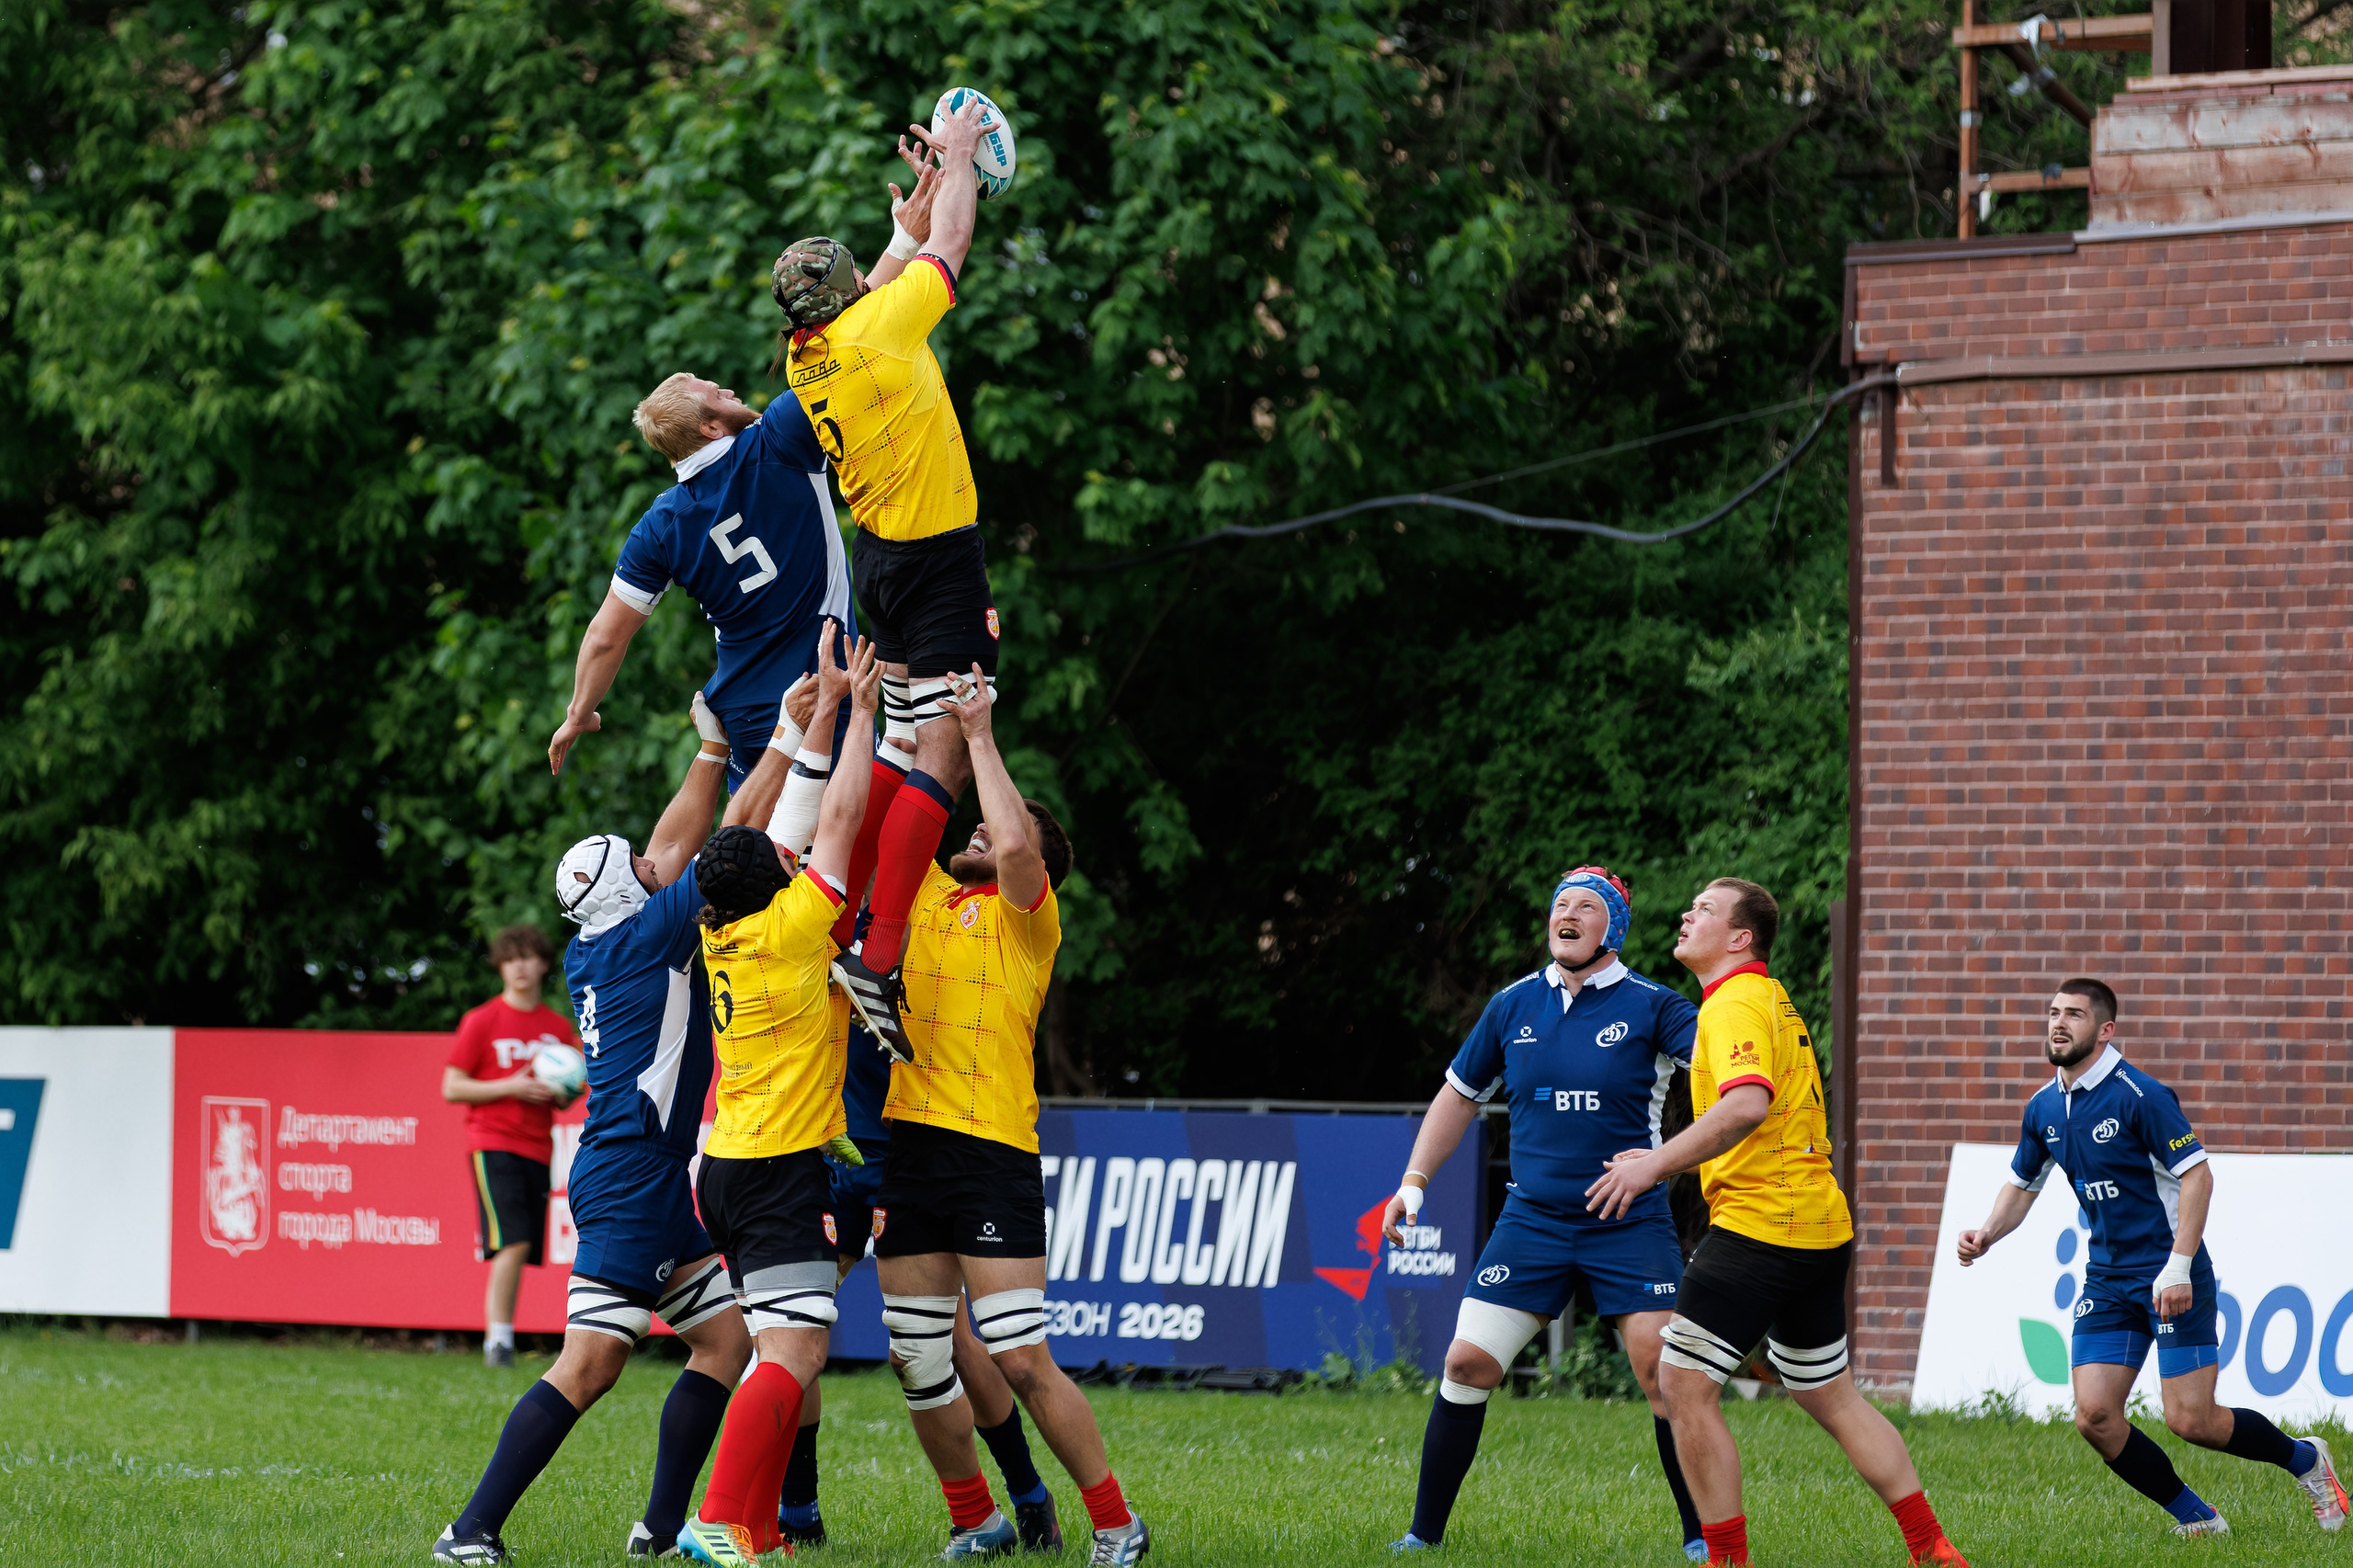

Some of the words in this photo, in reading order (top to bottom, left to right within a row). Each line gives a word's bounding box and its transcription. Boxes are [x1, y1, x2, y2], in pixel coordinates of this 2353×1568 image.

[710, 512, 779, 595] 5
[578, 984, 601, 1059] 4
[710, 970, 734, 1034] 6
[1555, 1090, 1601, 1111] ВТБ
[278, 1106, 418, 1153] Департамент
[278, 1162, 353, 1202] спорта
[2084, 1180, 2120, 1201] ВТБ
[278, 1210, 353, 1251] города
[353, 1207, 439, 1245] Москвы
[1088, 1156, 1298, 1289] РОССИИ
[1388, 1250, 1456, 1276] РОССИИ
[1654, 1283, 1677, 1295] ВТБ
[1117, 1302, 1205, 1341] 2026
[2158, 1324, 2174, 1334] ВТБ
